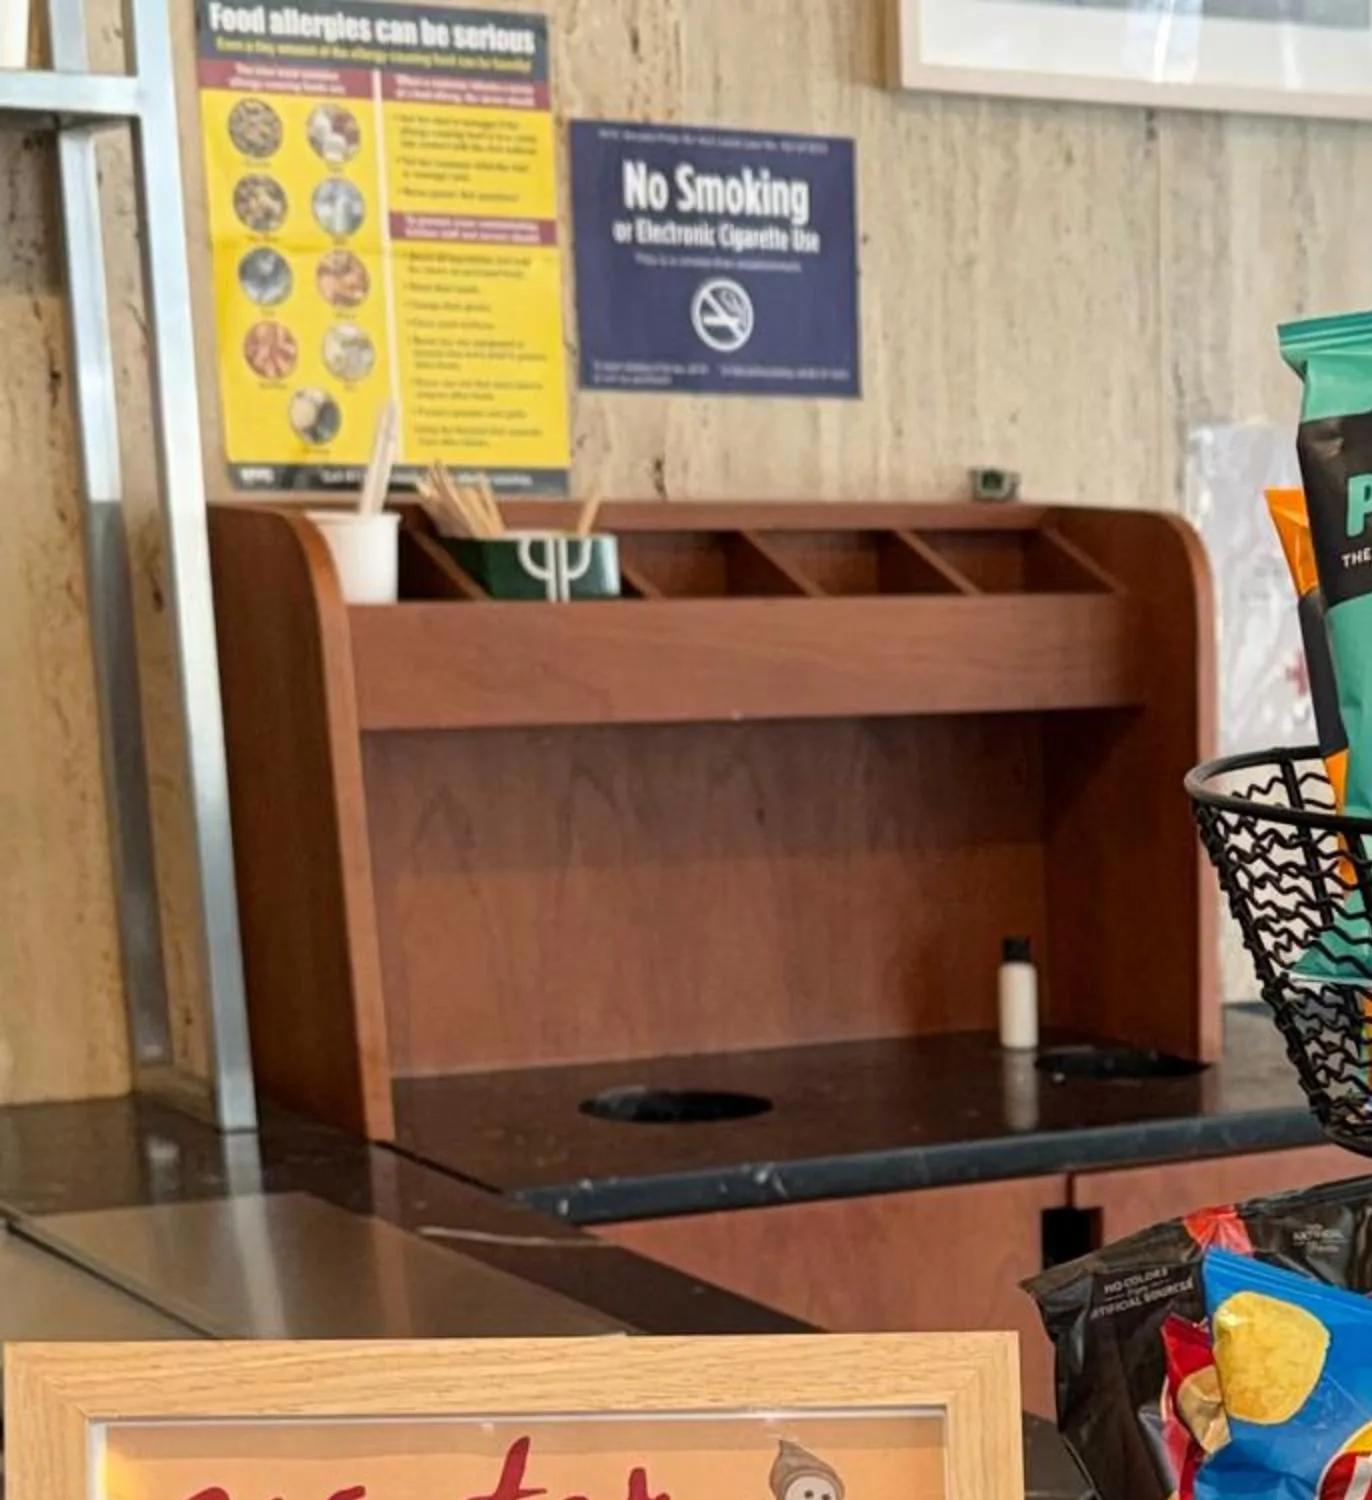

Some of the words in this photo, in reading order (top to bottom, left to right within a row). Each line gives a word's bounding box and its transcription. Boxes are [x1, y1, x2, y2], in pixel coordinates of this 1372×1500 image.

[209, 3, 266, 33] Food
[269, 9, 371, 42] allergies
[376, 21, 417, 45] can
[420, 18, 449, 48] be
[453, 25, 535, 54] serious
[622, 159, 668, 211] No
[675, 163, 809, 225] Smoking
[612, 221, 633, 243] or
[635, 218, 717, 248] Electronic
[719, 223, 789, 252] Cigarette
[792, 227, 821, 253] Use
[1342, 546, 1372, 568] THE
[1104, 1280, 1122, 1295] NO
